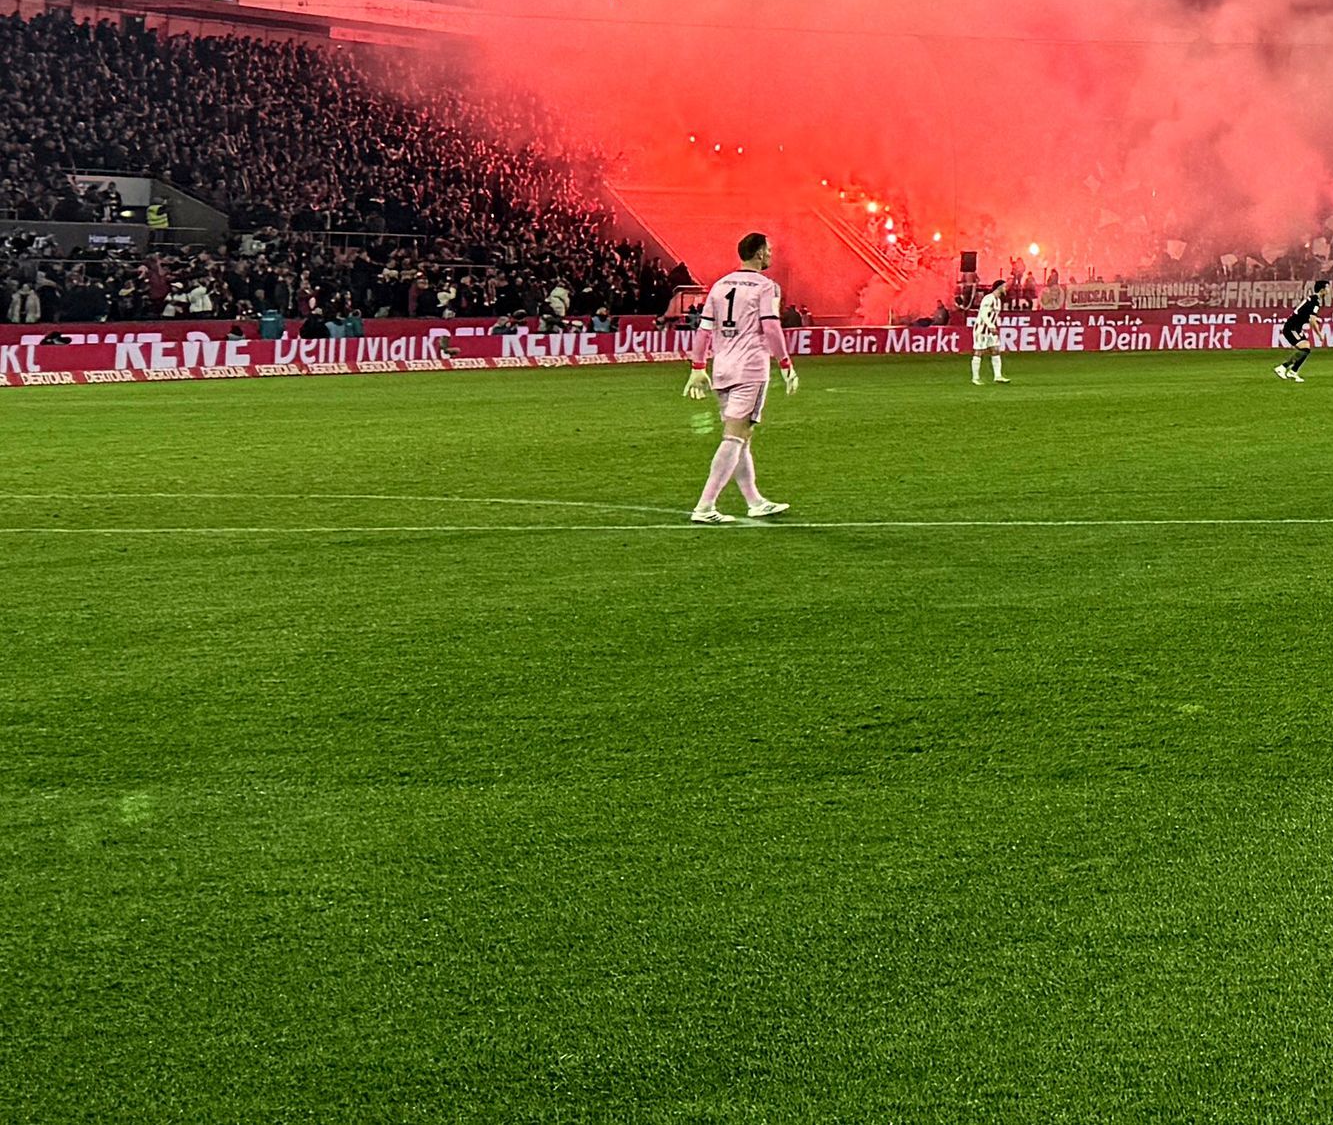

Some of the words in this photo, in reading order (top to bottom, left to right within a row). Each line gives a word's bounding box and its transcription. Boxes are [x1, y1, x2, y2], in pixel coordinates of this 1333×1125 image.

[723, 287, 737, 327] 1
[822, 328, 877, 354] Dein
[886, 327, 960, 353] Markt
[998, 326, 1084, 352] REWE
[1100, 326, 1151, 351] Dein
[1159, 325, 1233, 350] Markt
[20, 371, 76, 386] DERTOUR
[83, 369, 136, 383] DERTOUR
[143, 366, 194, 380] DERTOUR
